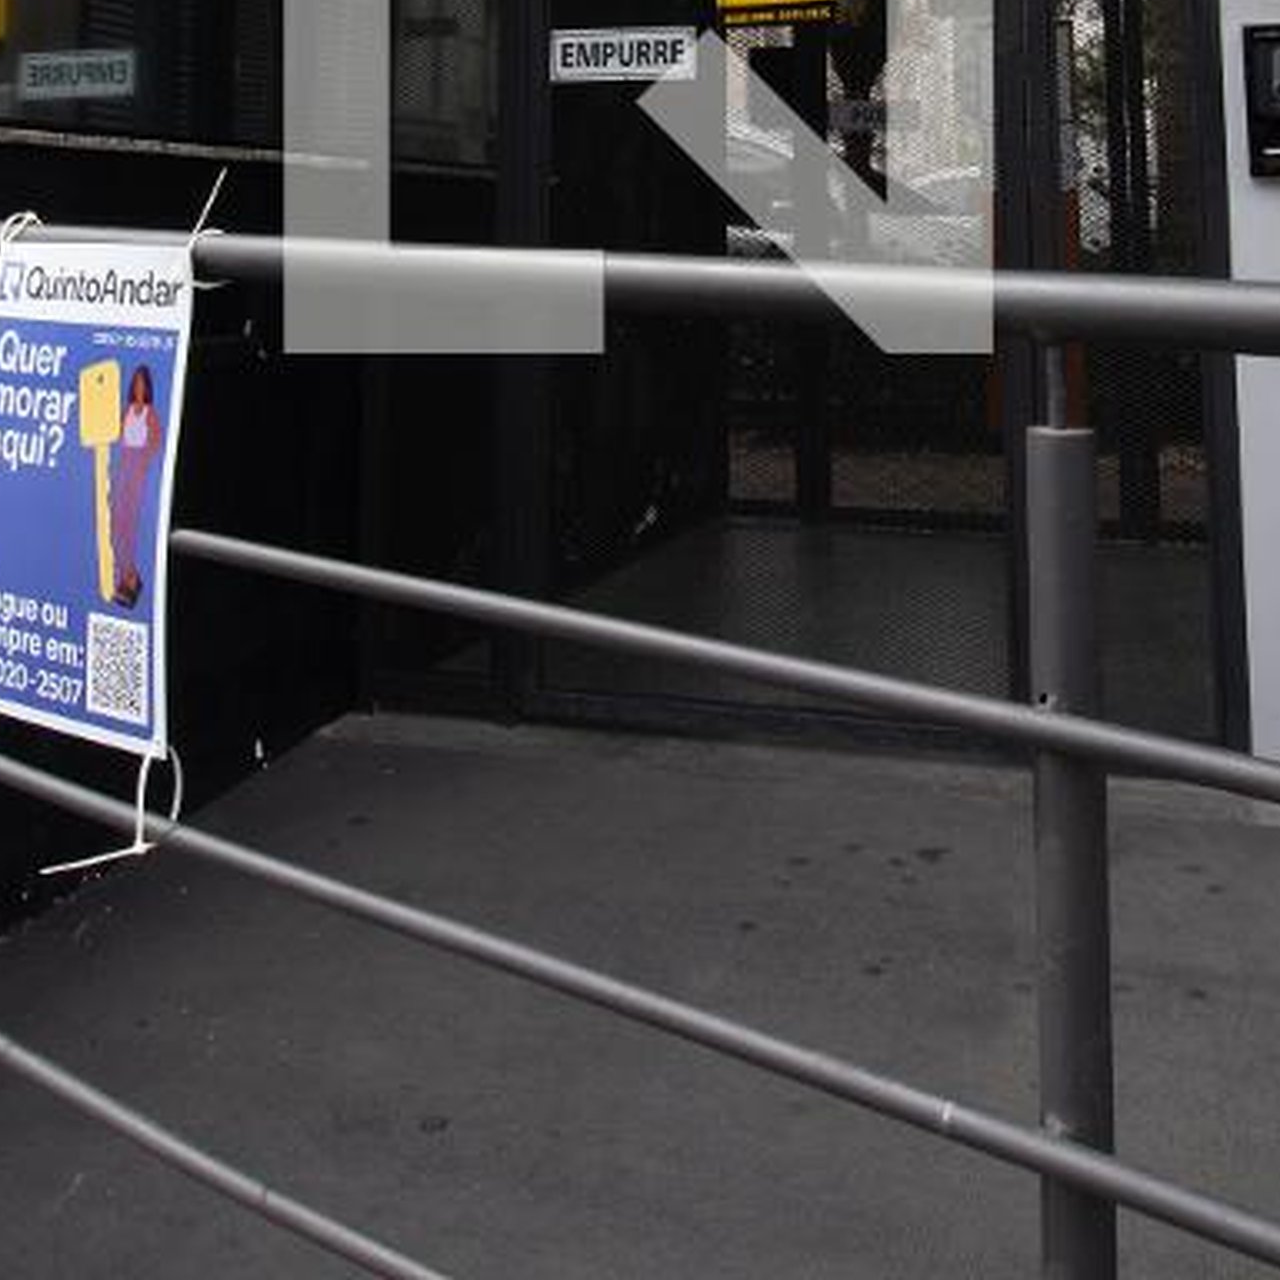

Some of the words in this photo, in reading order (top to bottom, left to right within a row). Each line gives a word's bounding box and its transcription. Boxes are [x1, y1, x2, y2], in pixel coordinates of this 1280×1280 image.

[560, 39, 684, 68] EMPURRE
[26, 266, 183, 308] QuintoAndar
[42, 602, 68, 629] ou
[45, 637, 84, 668] em:
